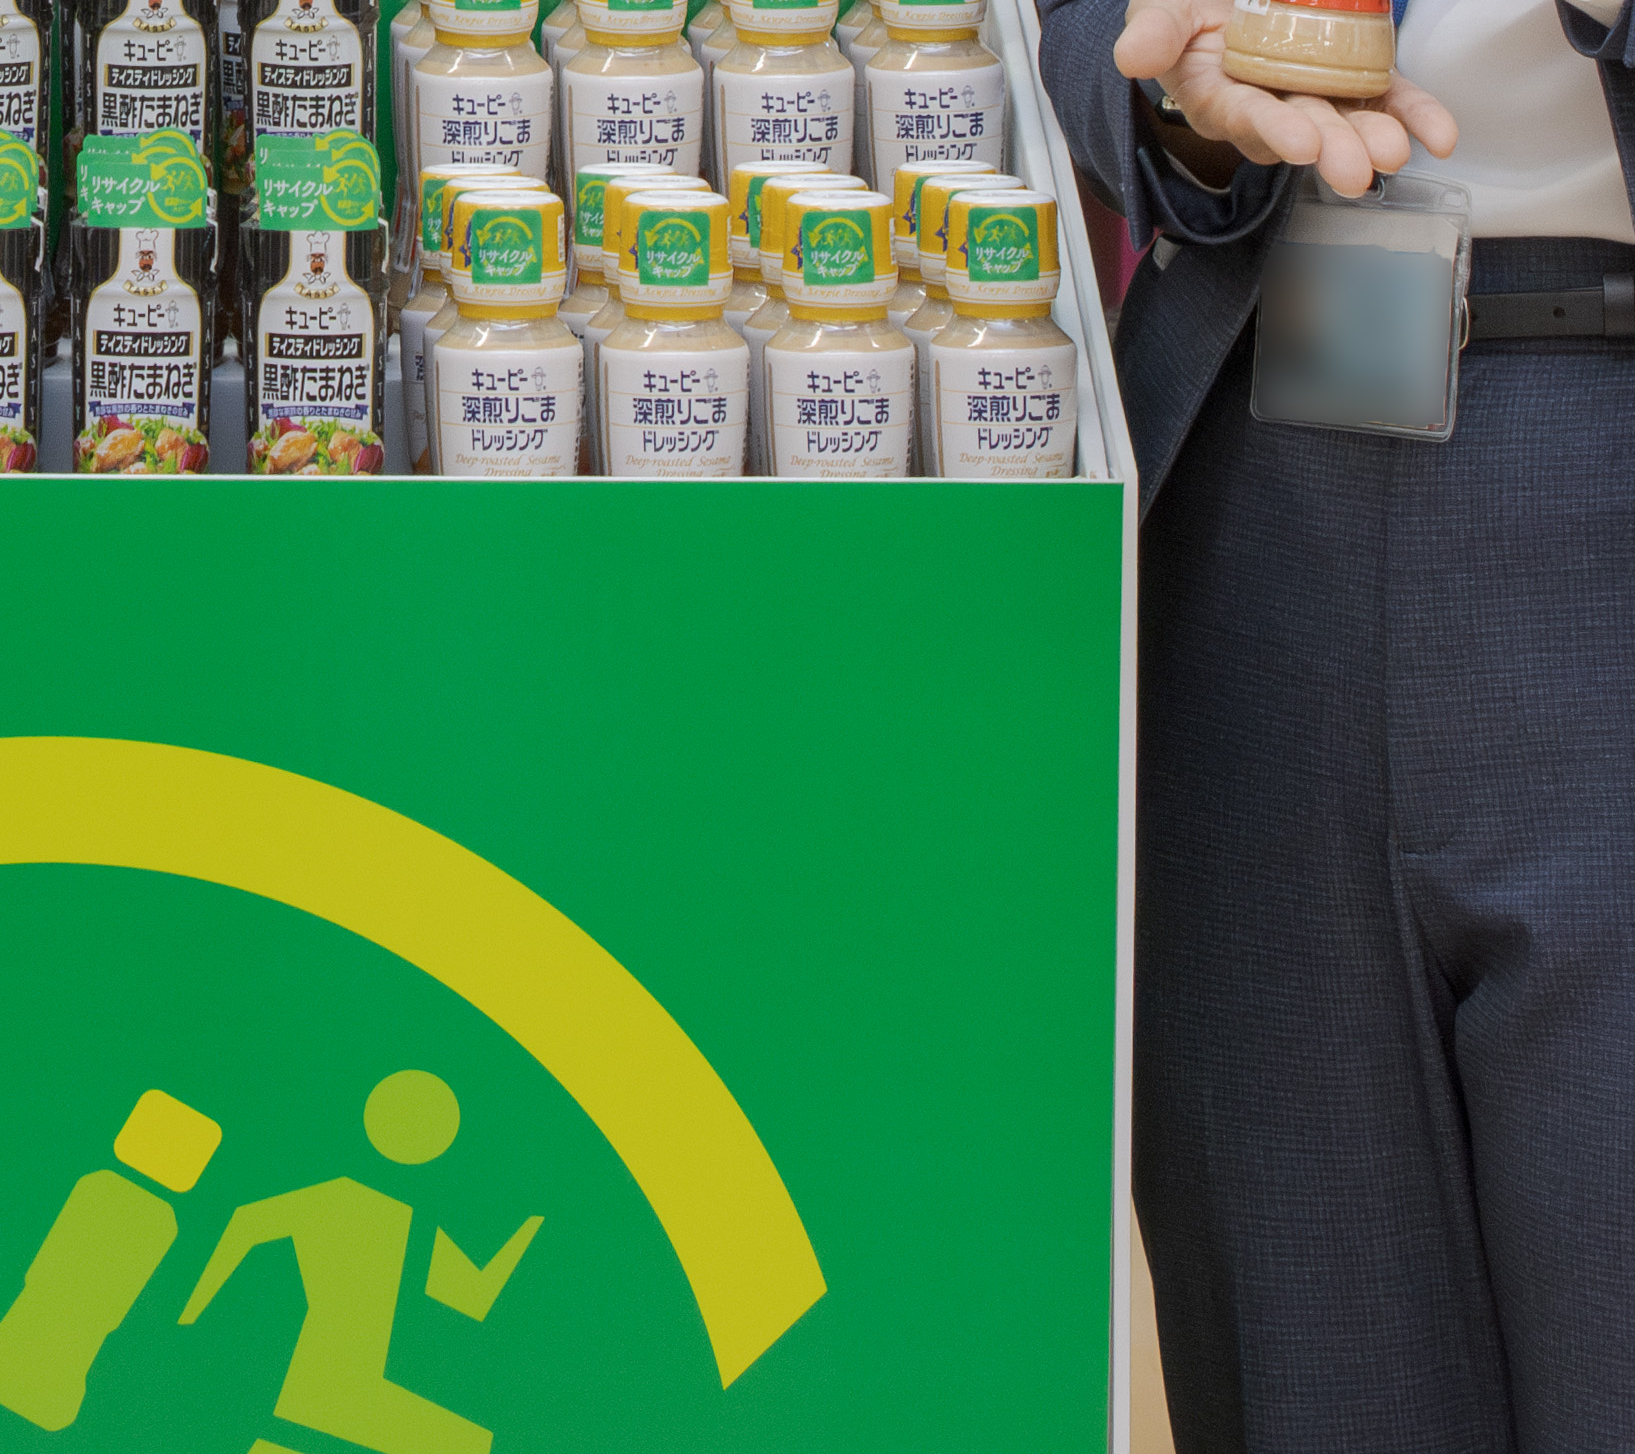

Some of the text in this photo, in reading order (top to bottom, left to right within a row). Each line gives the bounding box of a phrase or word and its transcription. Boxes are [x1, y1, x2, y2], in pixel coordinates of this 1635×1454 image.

[452, 93, 507, 116] キューピー
[442, 118, 531, 146] 深煎りごま
[284, 307, 337, 330] キューピー
[271, 336, 360, 359] テイスティドレッシング
[261, 362, 370, 403] 黒酢たまねぎ
[471, 369, 530, 392] キューピー
[978, 368, 1036, 391] キューピー
[461, 395, 557, 425] 深煎りごま
[967, 394, 1061, 423] 深煎りごま
[470, 428, 549, 453] ドレッシング
[976, 427, 1054, 452] ドレッシング
